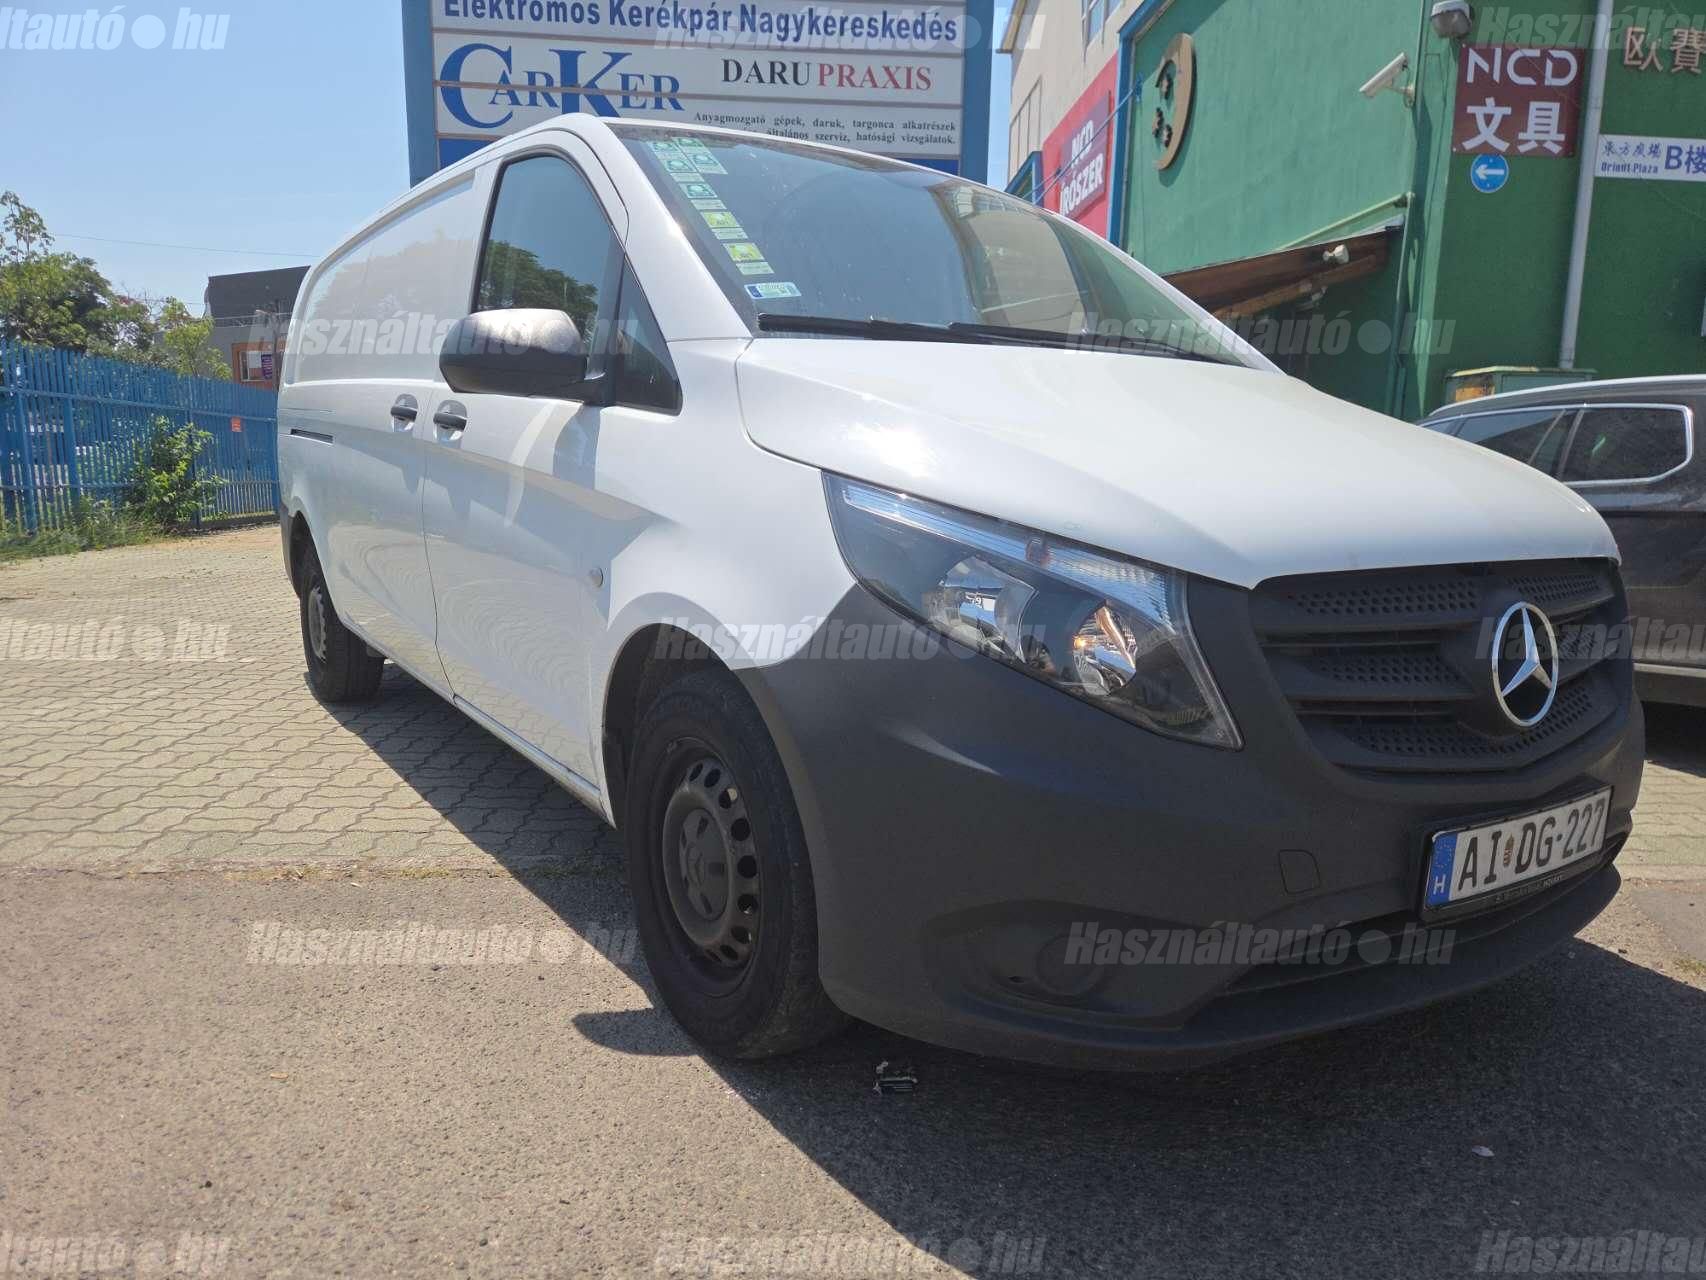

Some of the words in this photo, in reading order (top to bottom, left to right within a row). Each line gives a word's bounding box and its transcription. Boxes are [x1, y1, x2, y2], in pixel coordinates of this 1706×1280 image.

[444, 0, 600, 24] Elektromos
[609, 0, 732, 37] Kerékpár
[739, 2, 957, 43] Nagykereskedés
[1466, 47, 1578, 86] NCD
[693, 112, 766, 125] Anyagmozgató
[773, 116, 806, 127] gépek,
[812, 118, 845, 129] daruk,
[853, 119, 895, 131] targonca
[902, 119, 956, 132] alkatrészek
[1462, 96, 1566, 154] 文具
[856, 131, 895, 144] hatósági
[1433, 876, 1446, 895] H
